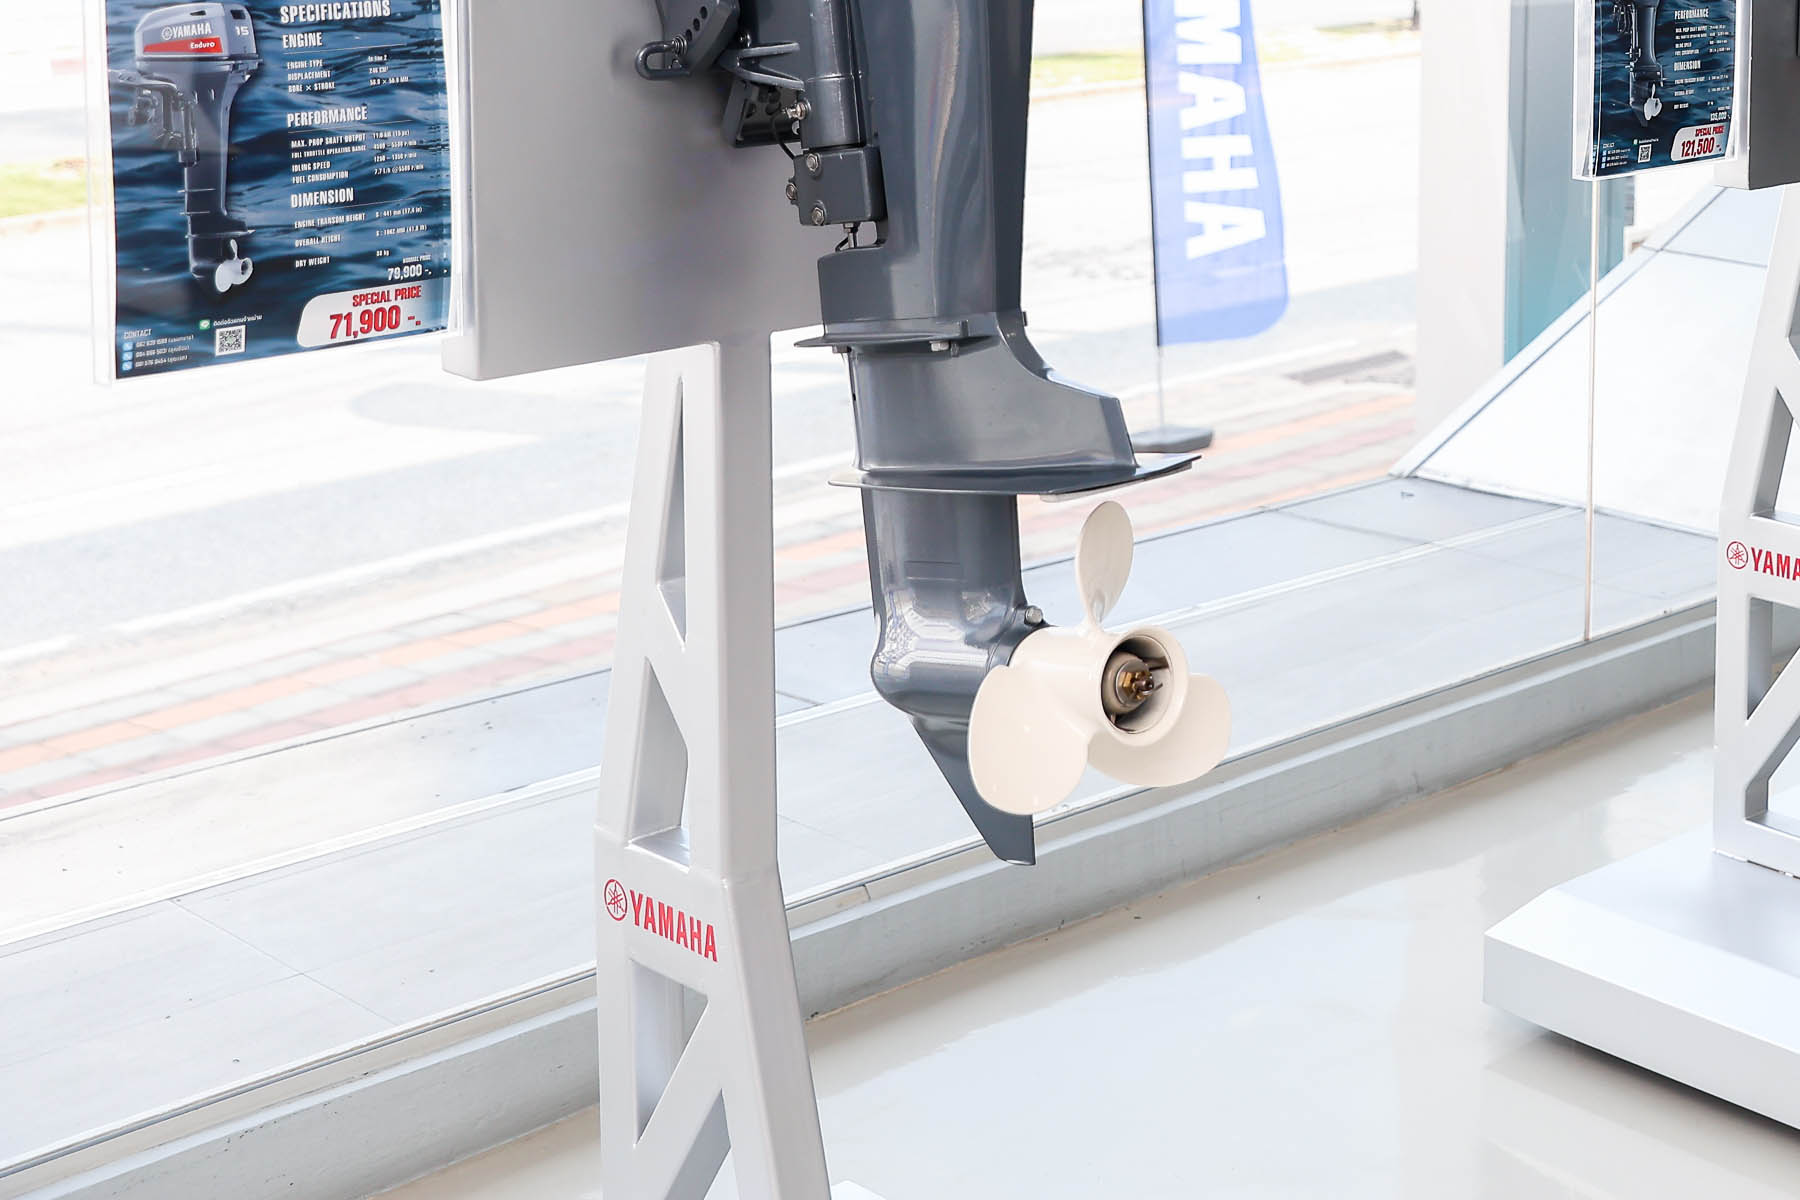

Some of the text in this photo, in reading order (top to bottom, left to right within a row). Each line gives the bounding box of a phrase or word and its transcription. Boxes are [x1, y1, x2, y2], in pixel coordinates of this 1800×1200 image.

[280, 0, 391, 24] SPECIFICATIONS
[1674, 8, 1709, 20] PERFORMANCE
[172, 22, 212, 39] YAMAHA
[235, 26, 249, 36] 15
[190, 41, 215, 49] Enduro
[282, 32, 323, 48] ENGINE
[288, 70, 331, 81] DISPLACEMENT
[287, 106, 368, 128] PERFORMANCE
[1681, 137, 1715, 157] 121,500
[313, 161, 331, 170] SPEED
[292, 170, 349, 184] FUEL CONSUMPTION
[290, 188, 354, 208] DIMENSION
[295, 256, 330, 268] DRY WEIGHT
[352, 285, 422, 307] SPECIAL PRICE
[330, 304, 401, 339] 71,900
[629, 889, 718, 963] YAMAHA
